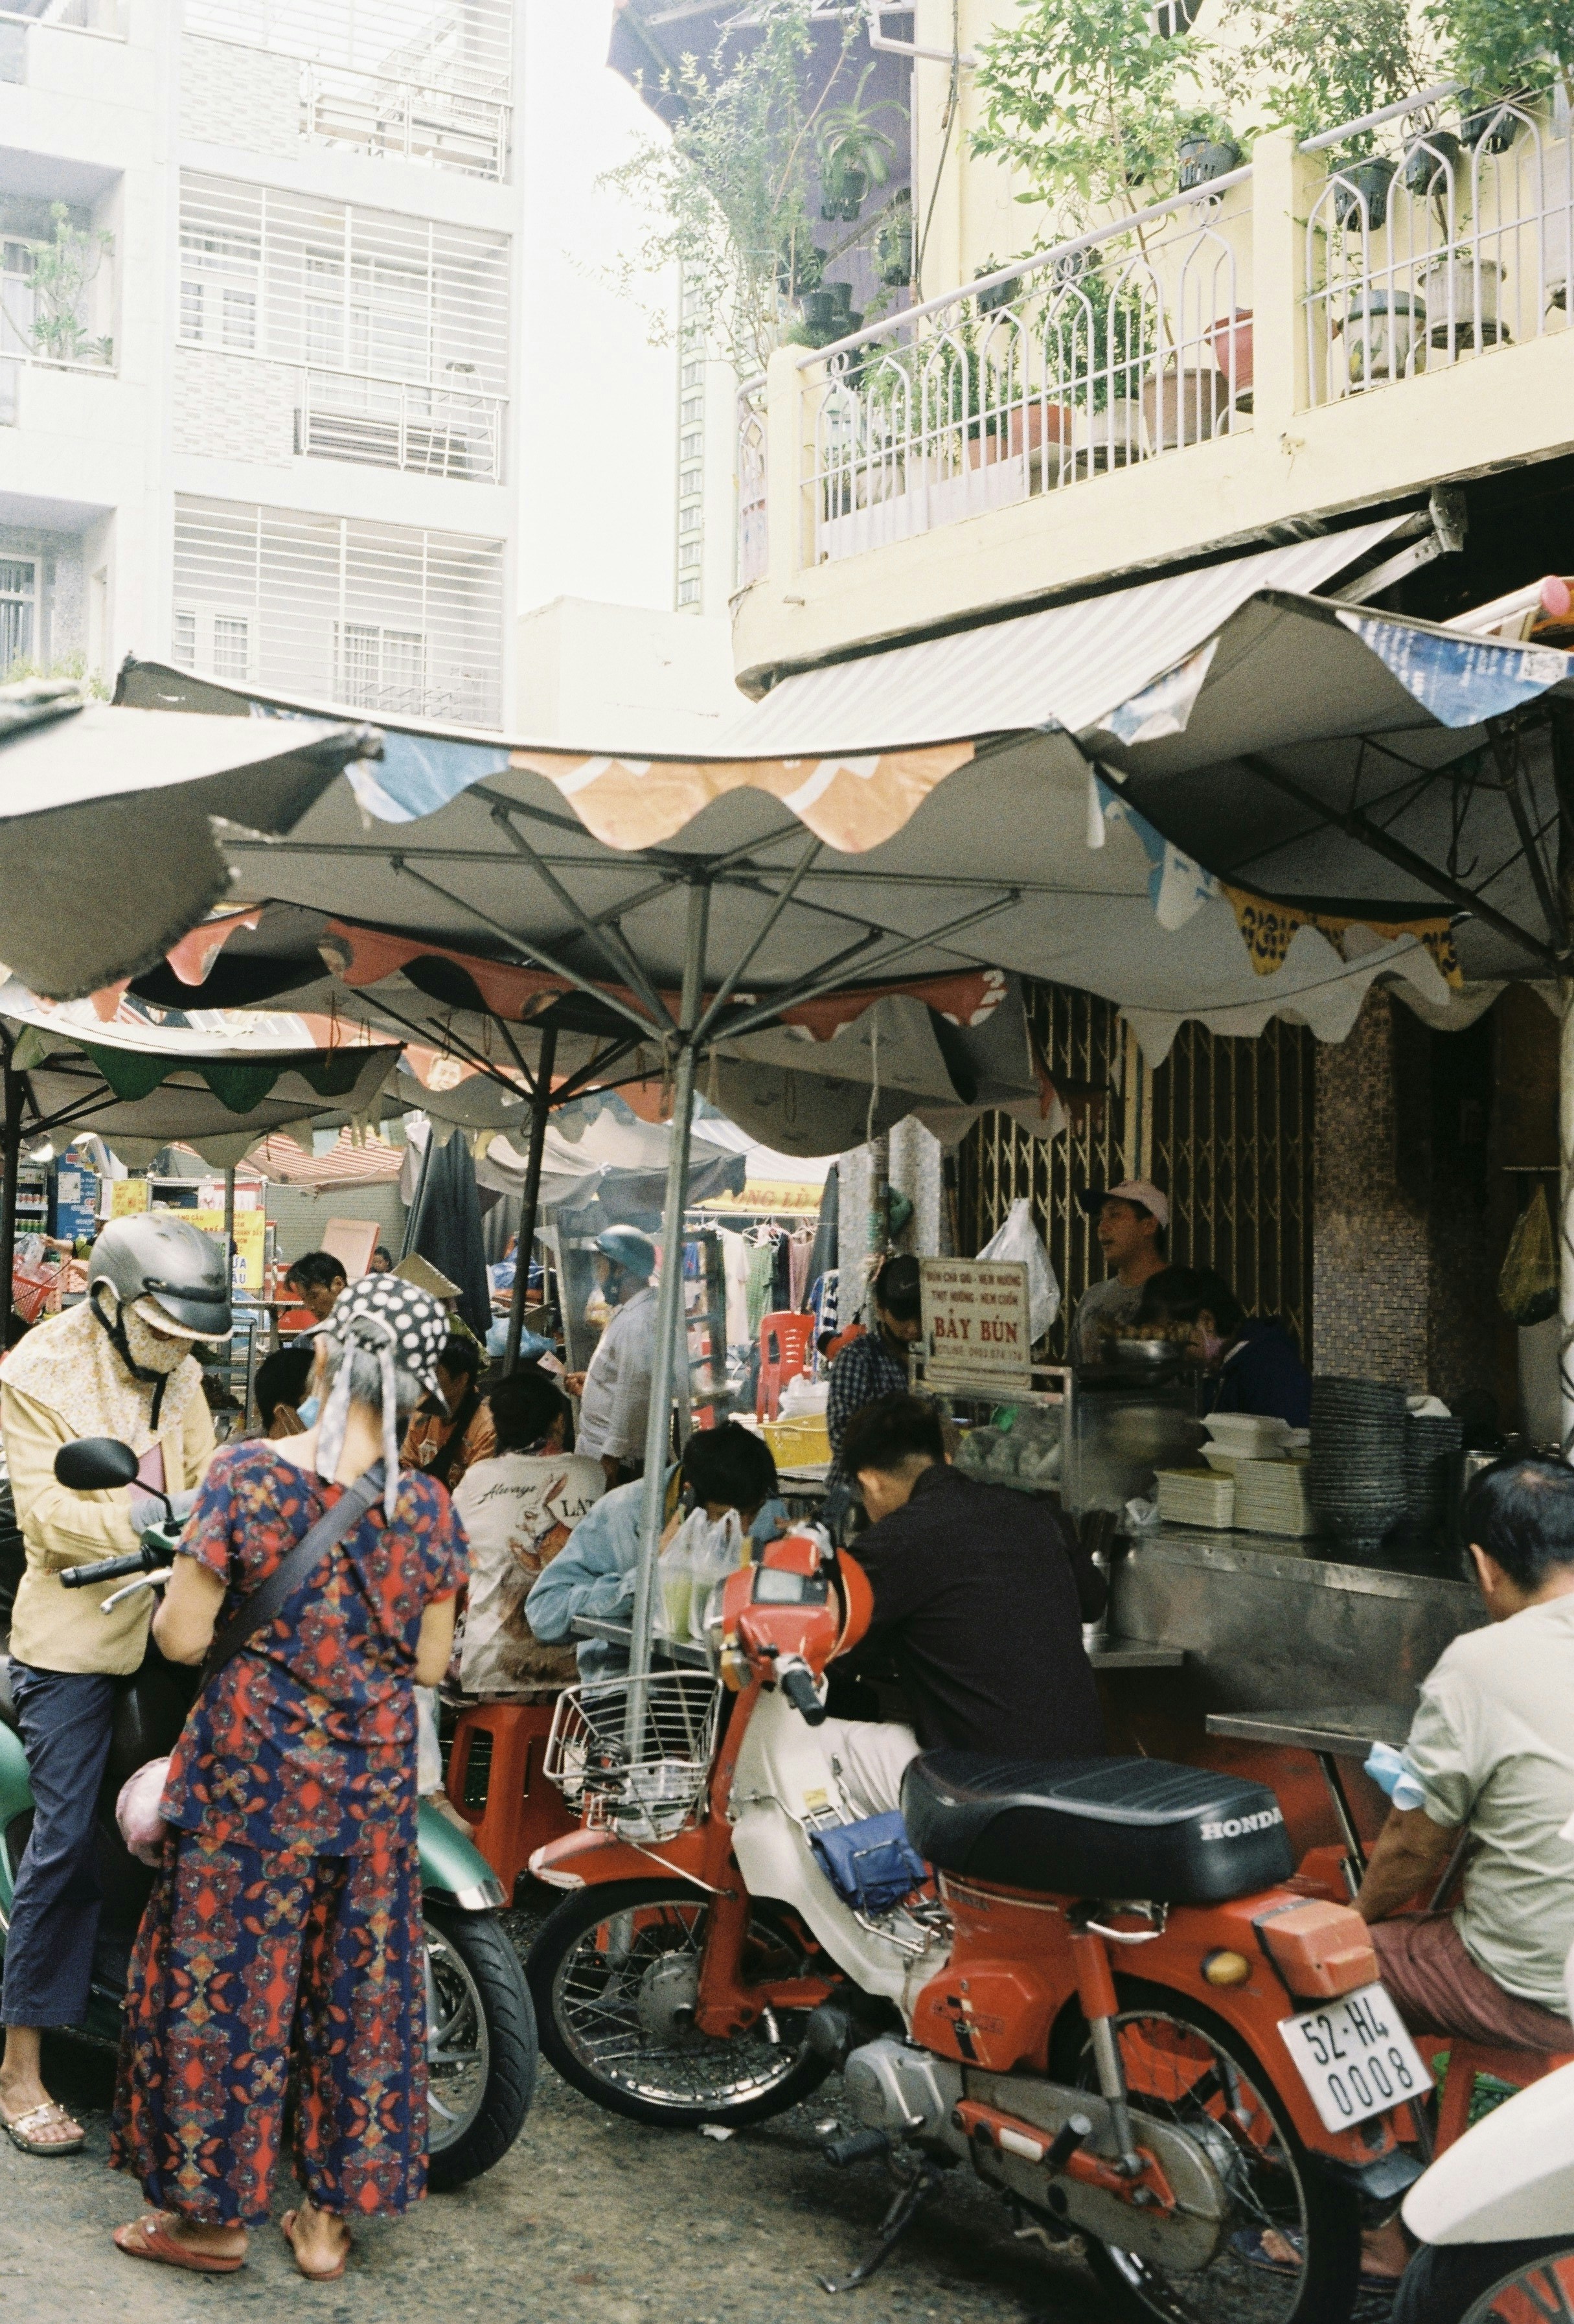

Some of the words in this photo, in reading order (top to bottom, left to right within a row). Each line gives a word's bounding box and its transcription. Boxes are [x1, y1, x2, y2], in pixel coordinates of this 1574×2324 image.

[933, 1307, 972, 1340] BẢY
[980, 1314, 1019, 1344] BÚN
[1327, 2046, 1413, 2116] 0008
